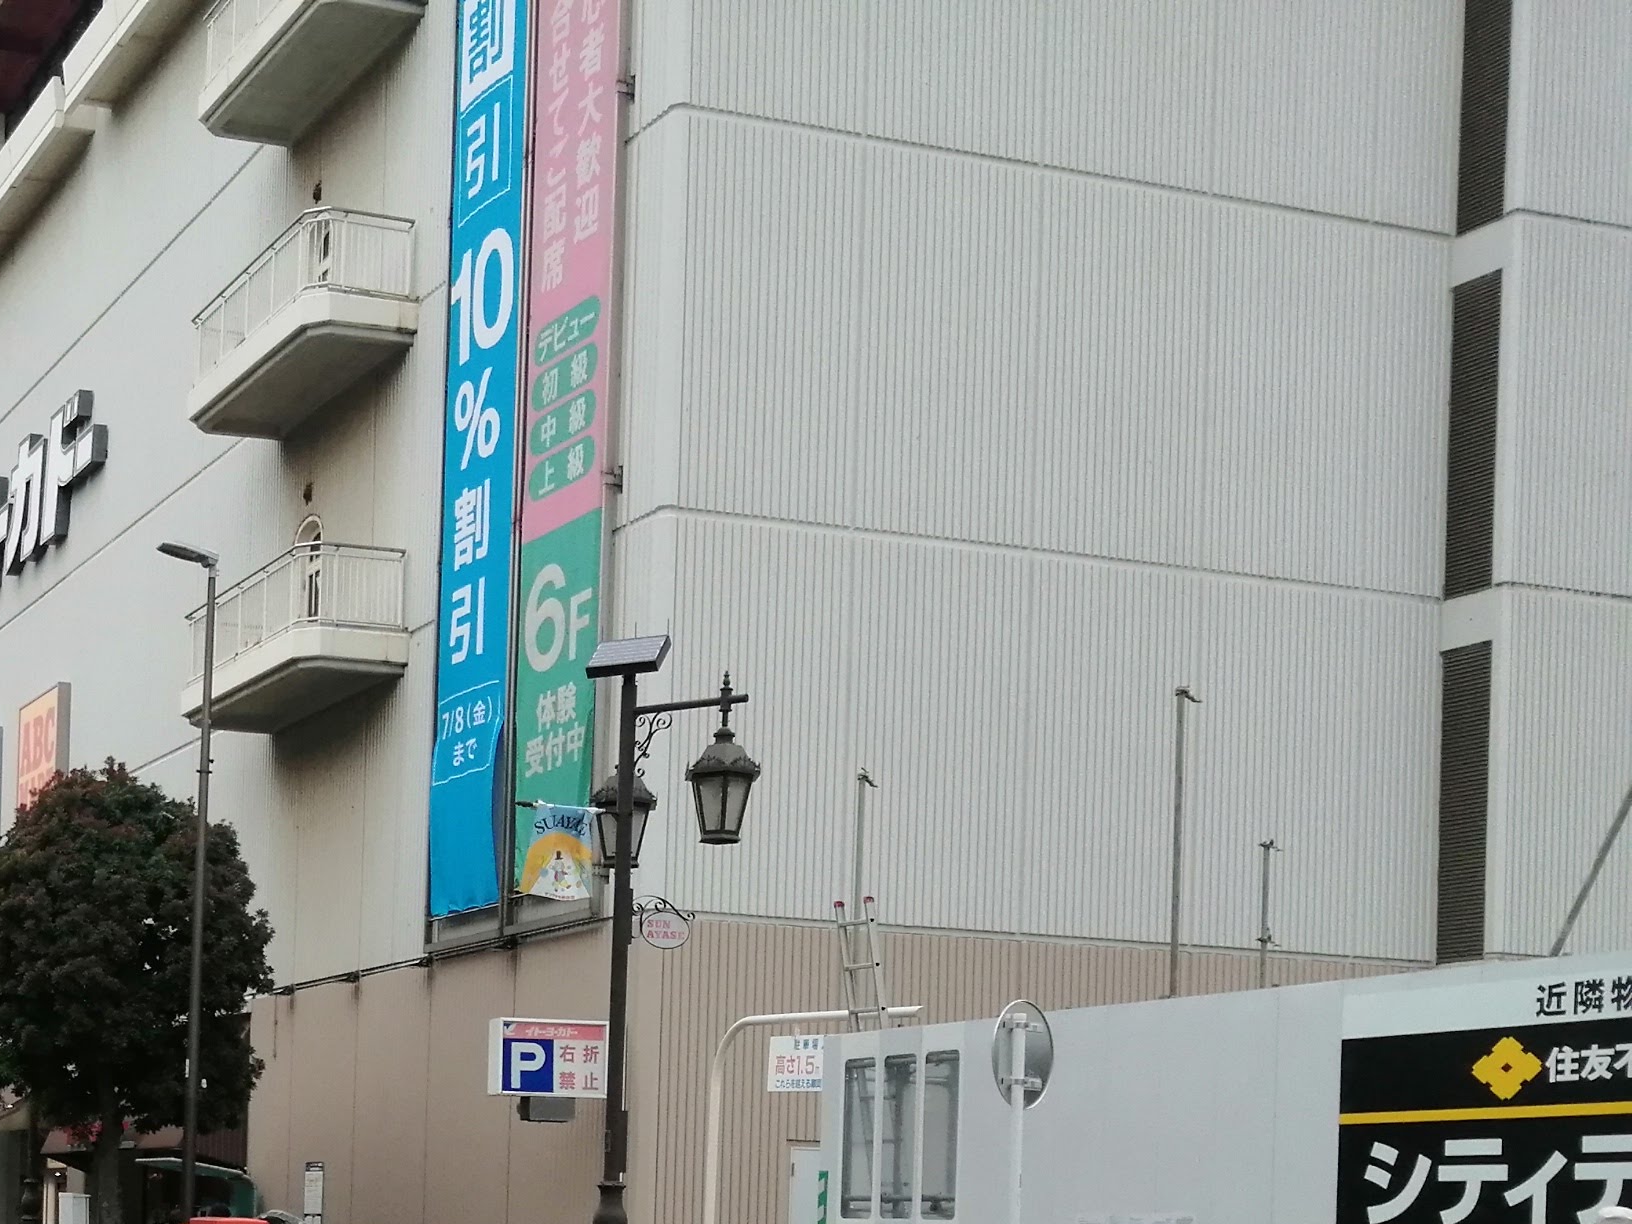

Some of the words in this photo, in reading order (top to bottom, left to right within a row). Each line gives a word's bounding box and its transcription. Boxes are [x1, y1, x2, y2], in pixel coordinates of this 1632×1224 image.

[538, 310, 596, 362] デビュー
[541, 349, 590, 405] 初級
[539, 396, 587, 448] 中級
[538, 441, 586, 497] 上級
[524, 563, 593, 672] 6F
[536, 680, 576, 733] 体験
[20, 706, 55, 778] ABC
[452, 738, 478, 767] まで
[525, 721, 586, 778] 受付中
[646, 930, 685, 940] AYASE
[647, 919, 671, 930] SUN
[510, 1041, 547, 1089] P
[559, 1044, 600, 1064] 右折
[559, 1071, 600, 1091] 禁止
